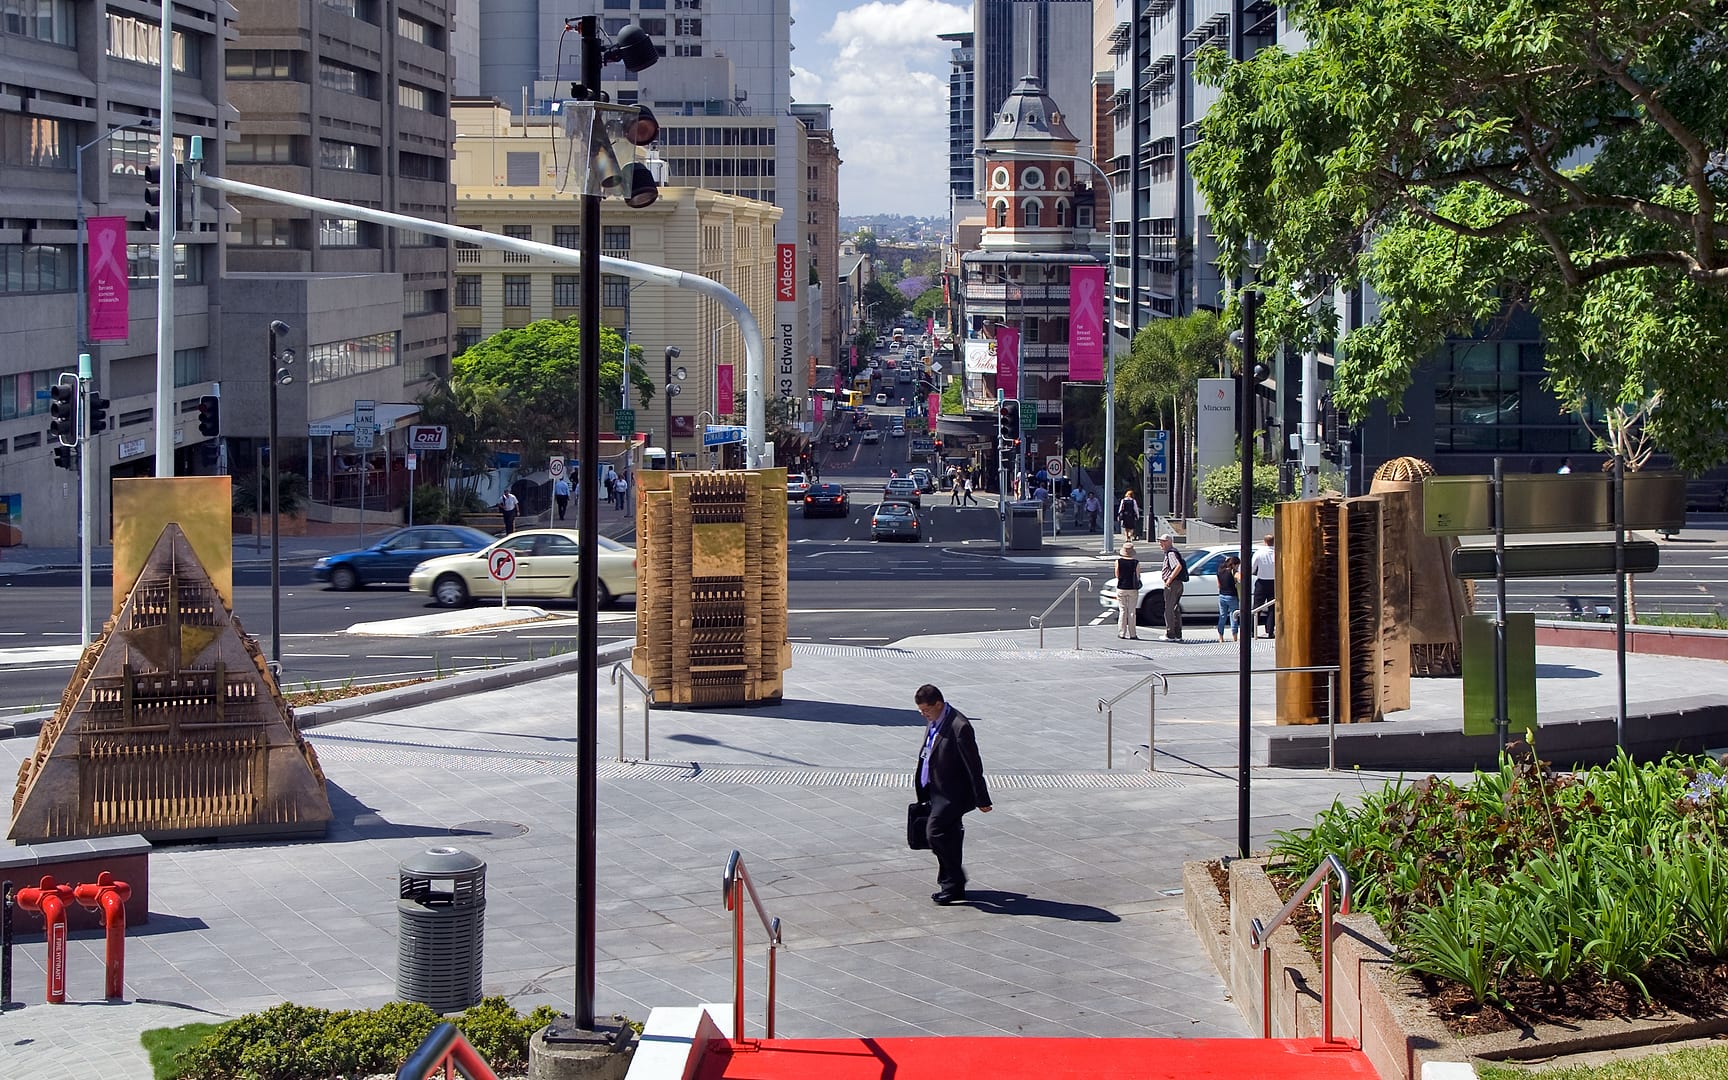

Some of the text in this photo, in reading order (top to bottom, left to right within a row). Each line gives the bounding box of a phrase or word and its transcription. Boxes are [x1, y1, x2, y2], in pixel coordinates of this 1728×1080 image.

[780, 248, 793, 298] Adecco
[780, 323, 793, 375] Edward
[705, 433, 723, 442] EDWARD
[1049, 463, 1059, 471] 40
